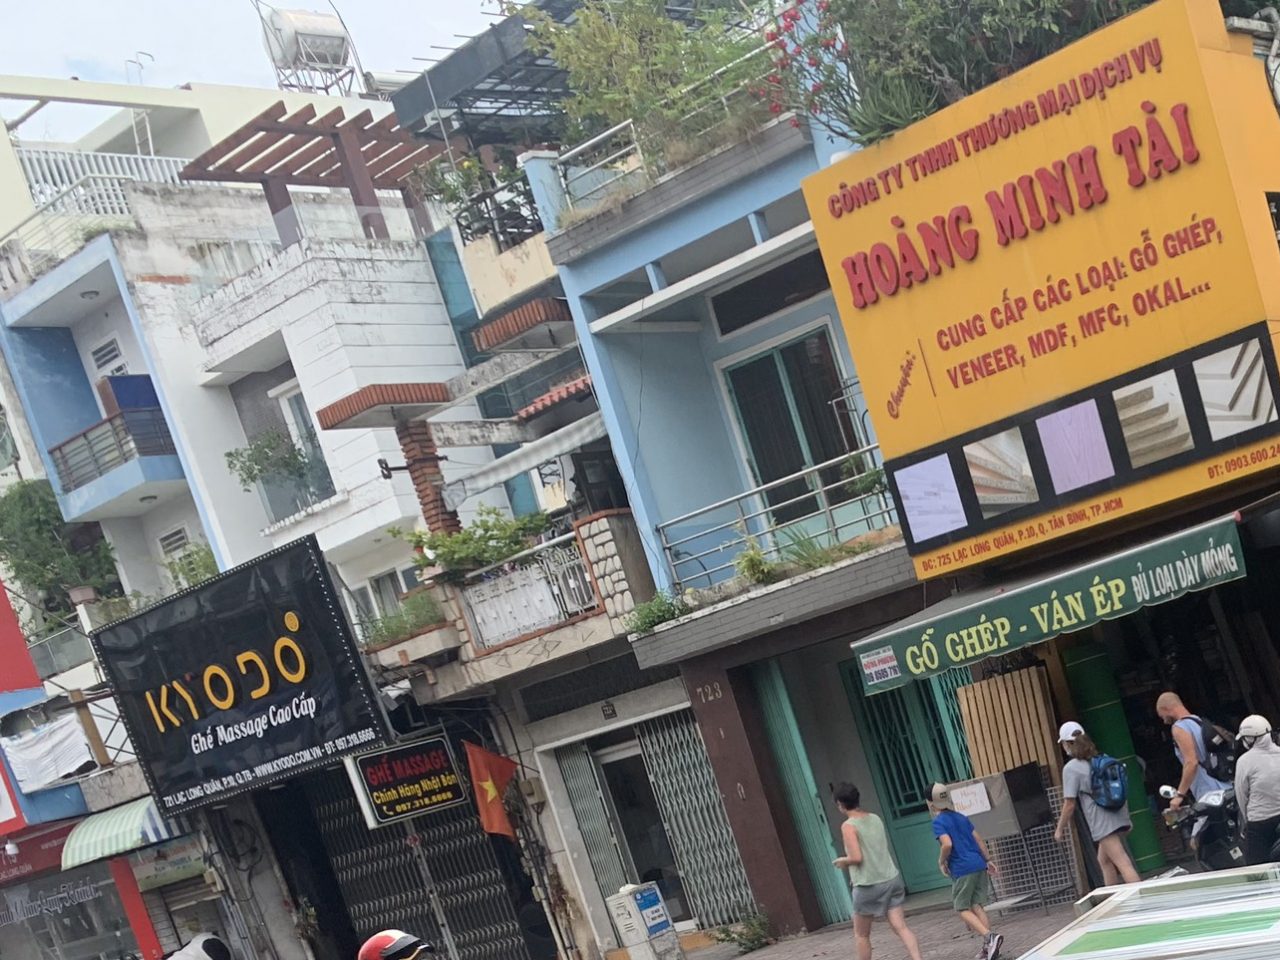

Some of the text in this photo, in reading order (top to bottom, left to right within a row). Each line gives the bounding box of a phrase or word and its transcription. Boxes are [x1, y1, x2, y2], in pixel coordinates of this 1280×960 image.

[828, 38, 1162, 219] CÔNG TY TNHH THƯƠNG MẠI DỊCH VỤ
[841, 100, 1200, 309] HOÀNG MINH TÀI
[936, 213, 1223, 351] CUNG CẤP CÁC LOẠI: GỖ GHÉP,
[946, 344, 1026, 389] VENEER,
[1027, 322, 1077, 359] MDF,
[1078, 302, 1129, 339] MFC,
[937, 554, 952, 567] 725
[1089, 496, 1124, 517] TP.HCM
[905, 537, 1239, 675] GỖ GHÉP VÁN ÉP ĐỦ LOẠI DÀY MỎNG
[190, 691, 316, 754] Ghế Massage Cao Cấp
[696, 682, 722, 703] 723
[366, 754, 393, 785] GHẾ
